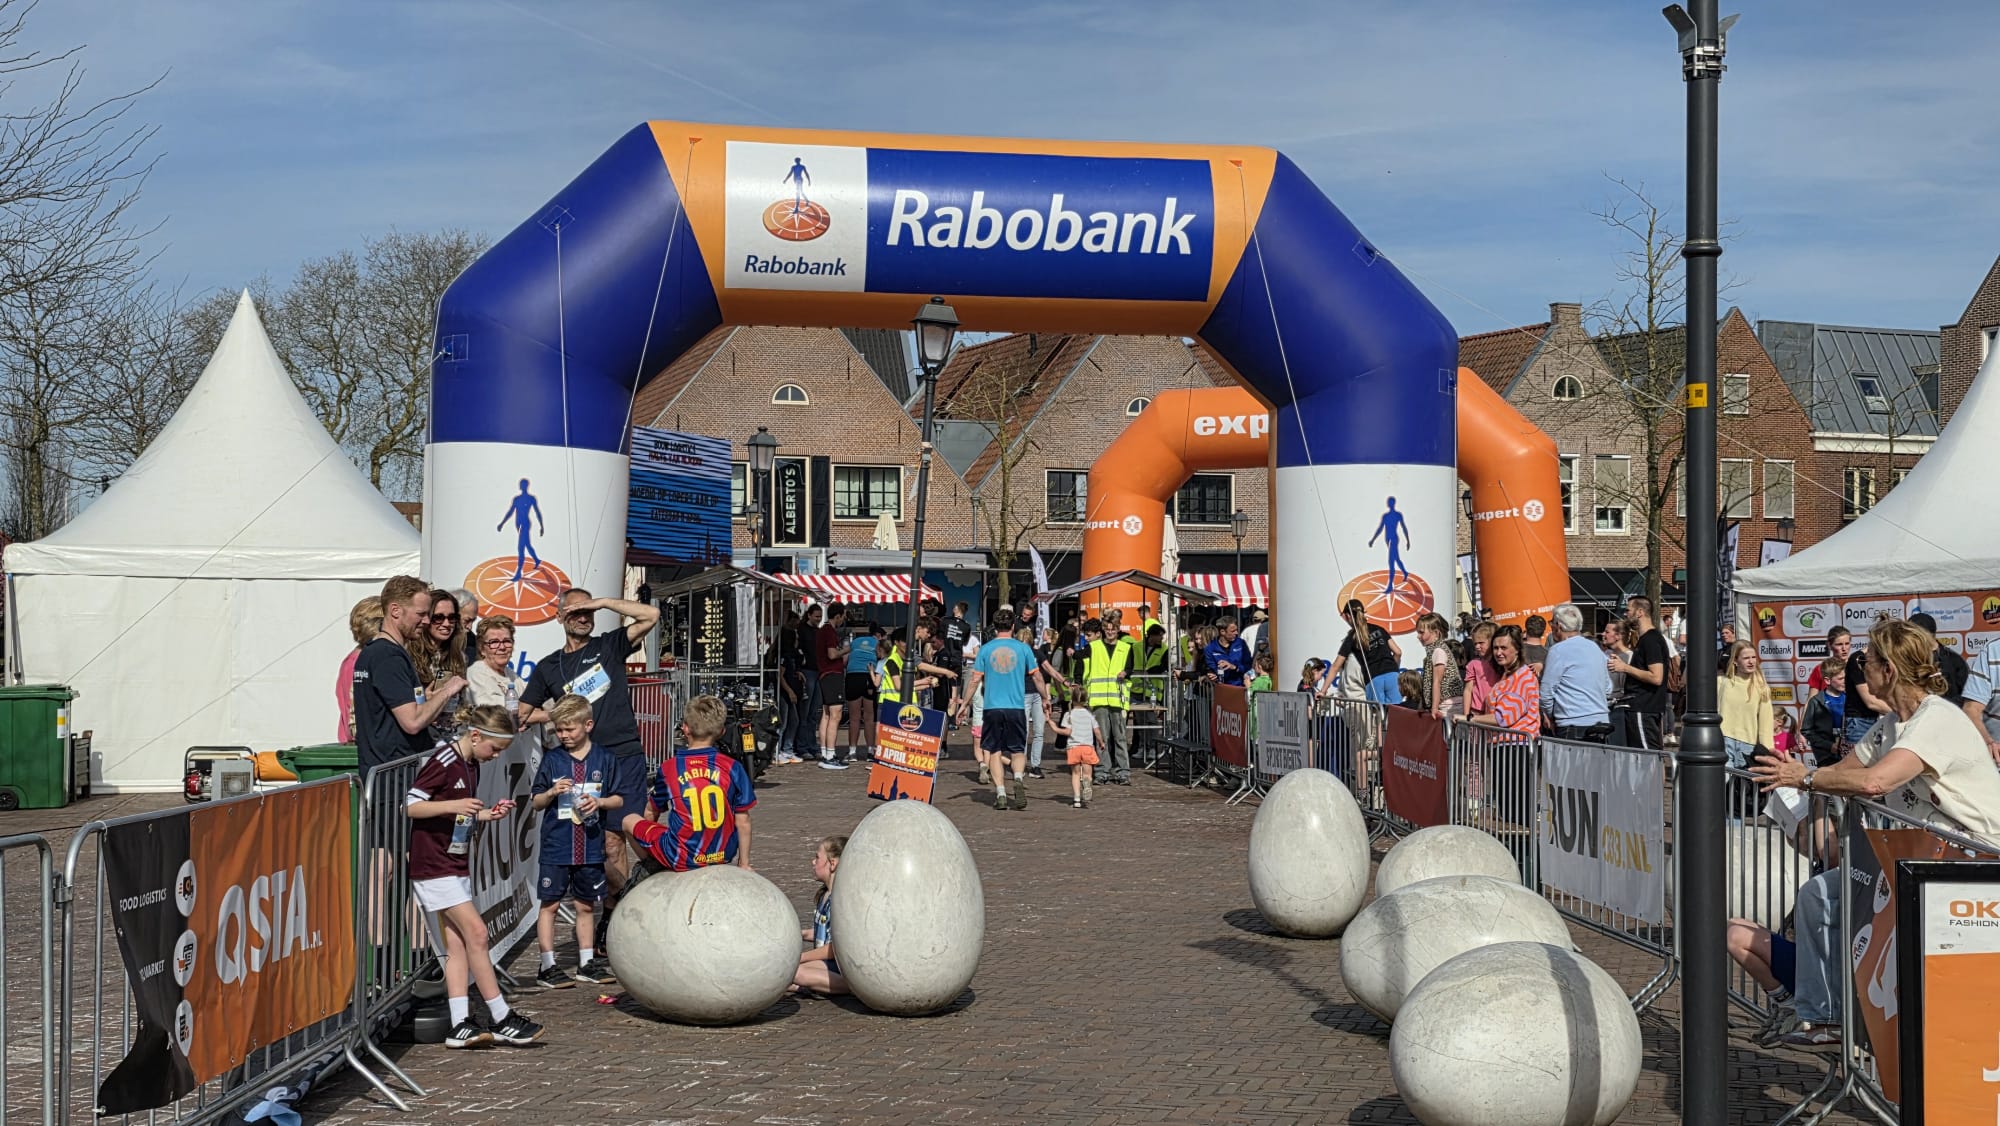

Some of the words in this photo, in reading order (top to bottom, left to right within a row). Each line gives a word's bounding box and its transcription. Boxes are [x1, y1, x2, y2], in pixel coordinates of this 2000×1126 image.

[886, 188, 1196, 256] Rabobank
[744, 253, 847, 277] Rabobank
[1193, 414, 1269, 438] exp
[785, 468, 797, 535] ALBERTO'S
[1086, 519, 1120, 531] xpert
[1761, 644, 1792, 655] Rabobank
[1222, 709, 1242, 738] COVEBO
[876, 745, 882, 757] 8
[883, 747, 907, 764] APRIL
[907, 754, 935, 770] 2026
[678, 768, 721, 785] FABIAN
[682, 784, 726, 832] 10
[1547, 783, 1599, 859] RUN
[119, 896, 139, 912] FOOD
[139, 888, 167, 908] LOGISTICS
[1949, 919, 1999, 927] FASHION
